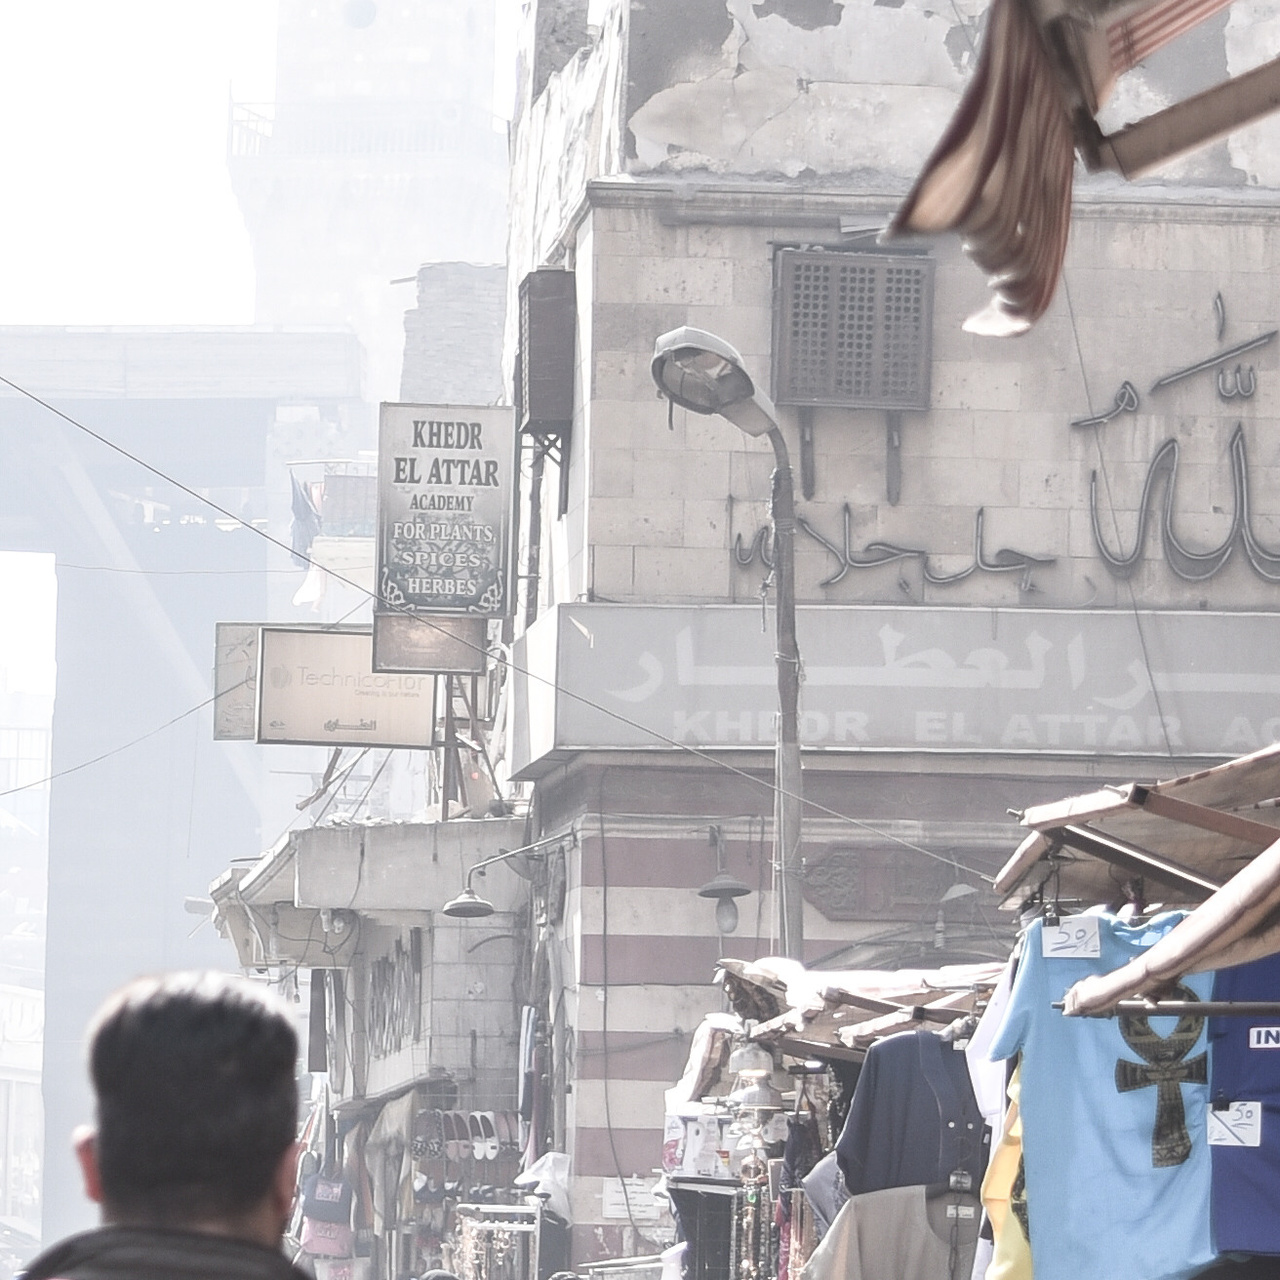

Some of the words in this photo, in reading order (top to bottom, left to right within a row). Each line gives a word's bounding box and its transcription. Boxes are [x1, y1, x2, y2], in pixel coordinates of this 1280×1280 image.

[412, 420, 483, 450] KHEDR
[393, 457, 422, 484] EL
[427, 457, 499, 487] ATTAR
[410, 494, 474, 511] ACADEMY
[393, 522, 425, 540] FOR
[408, 578, 477, 596] HERBES
[915, 711, 983, 744] EL
[1001, 714, 1184, 746] ATTAR
